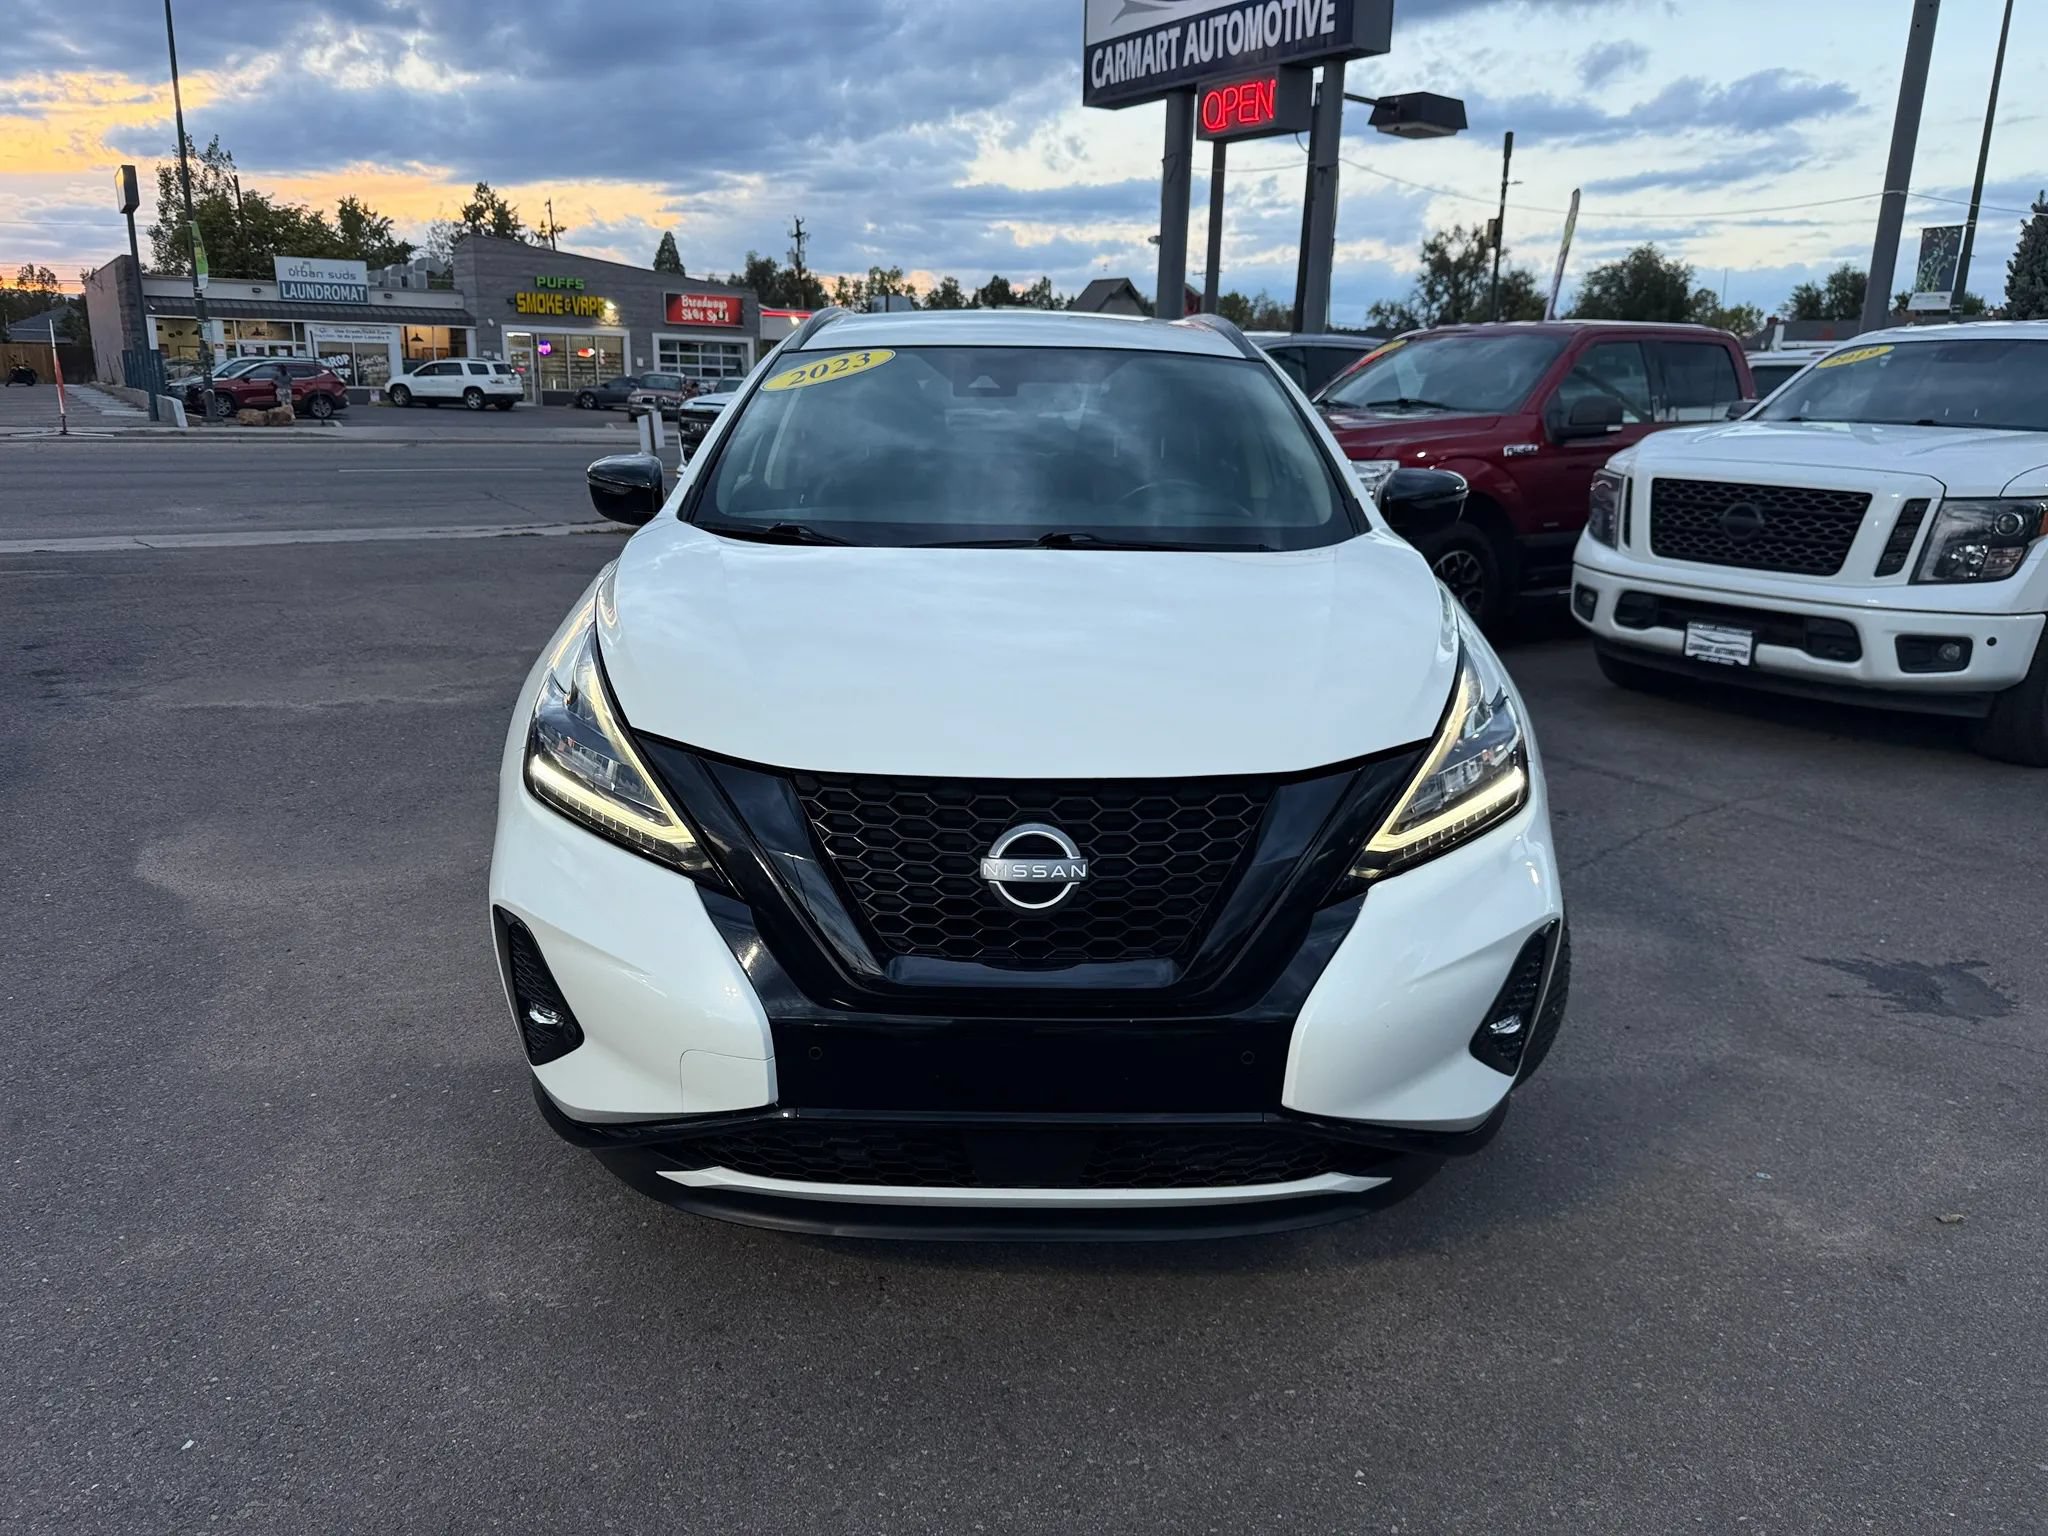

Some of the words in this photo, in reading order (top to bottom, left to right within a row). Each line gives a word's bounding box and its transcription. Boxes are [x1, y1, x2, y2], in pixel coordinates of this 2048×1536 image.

[1091, 32, 1182, 89] CARMART
[1183, 0, 1335, 67] AUTOMOTIVE
[1202, 78, 1277, 132] OPEN
[328, 269, 357, 281] suds
[536, 276, 585, 290] PUFFS
[282, 282, 366, 302] LAUNDROMAT
[516, 292, 564, 315] SMOKE
[787, 352, 871, 386] 2023
[983, 862, 1087, 878] NISSAN
